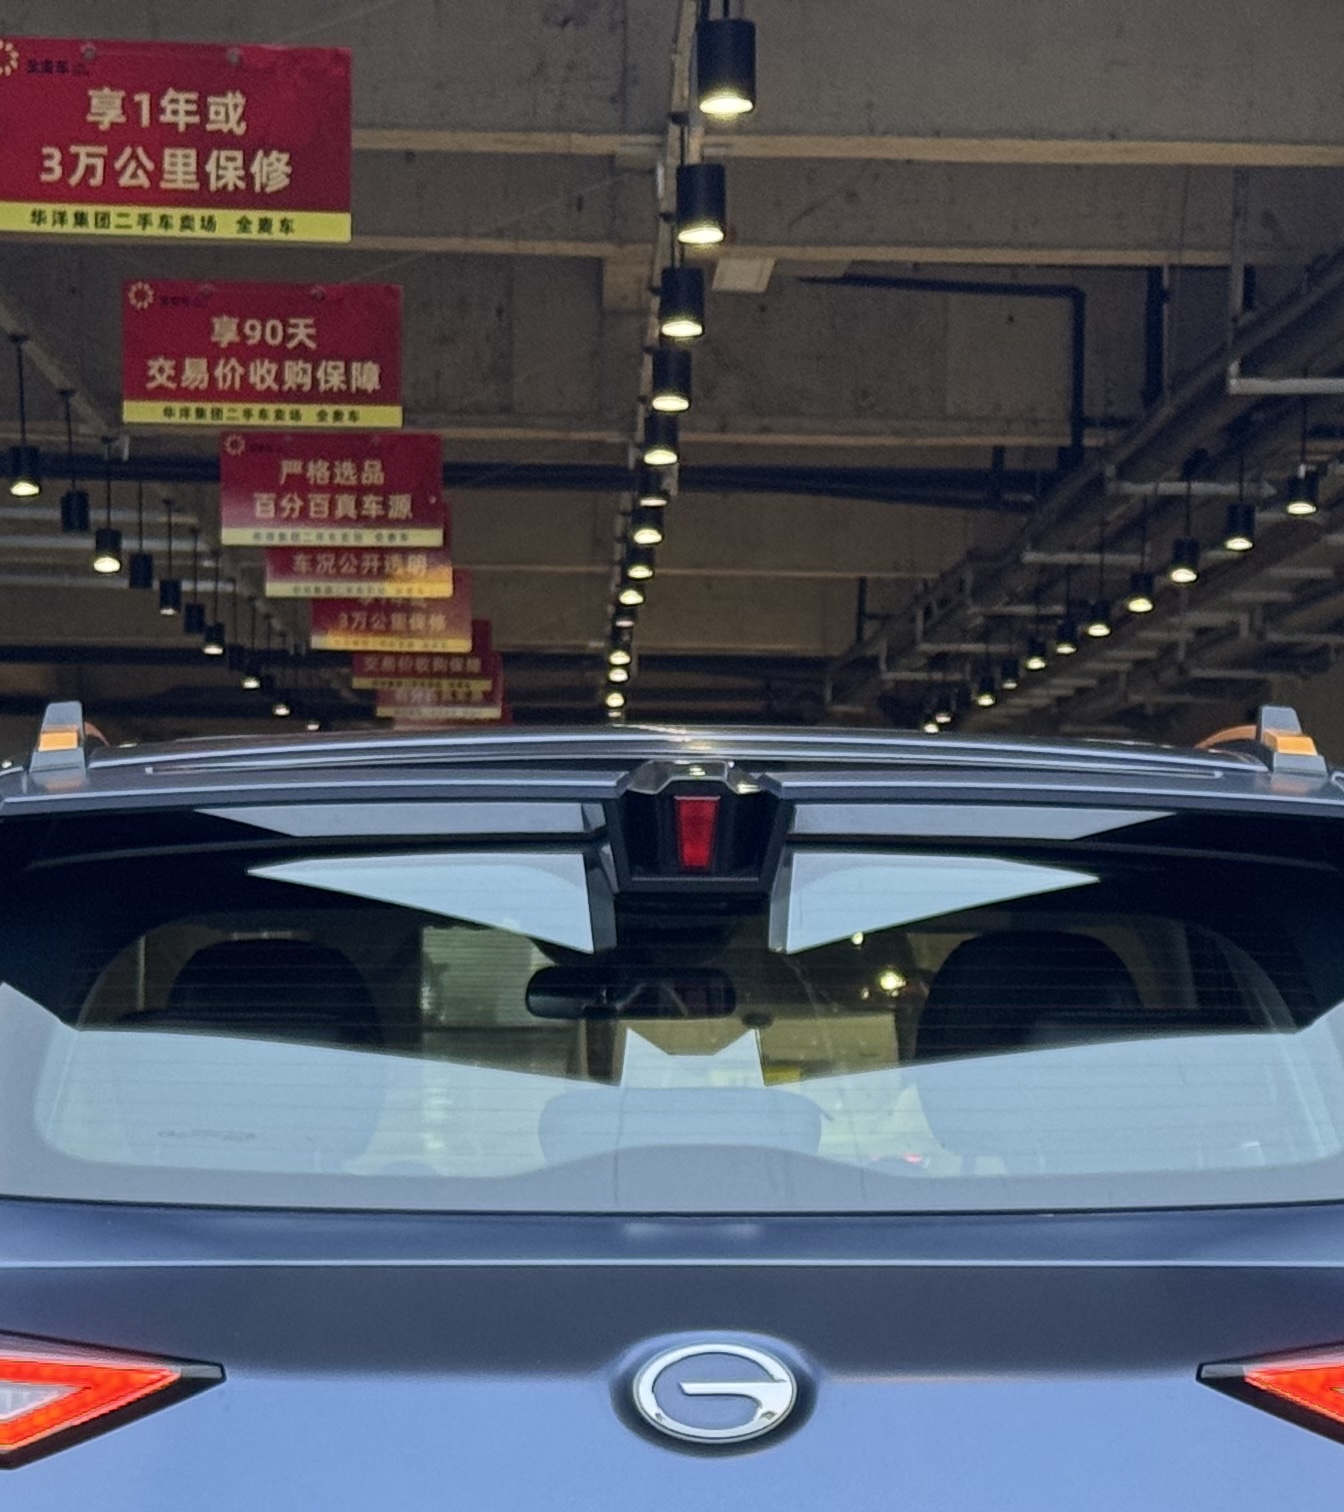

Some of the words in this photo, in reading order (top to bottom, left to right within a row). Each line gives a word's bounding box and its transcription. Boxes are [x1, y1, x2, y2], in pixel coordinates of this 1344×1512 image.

[85, 86, 248, 136] 享1年或
[39, 144, 294, 194] 3万公里保修
[30, 209, 218, 233] 华洋集团二手车卖场
[210, 314, 318, 350] 享90天
[146, 356, 382, 393] 交易价收购保障
[279, 458, 385, 486] 严格选品
[253, 492, 413, 520] 百分百真车源
